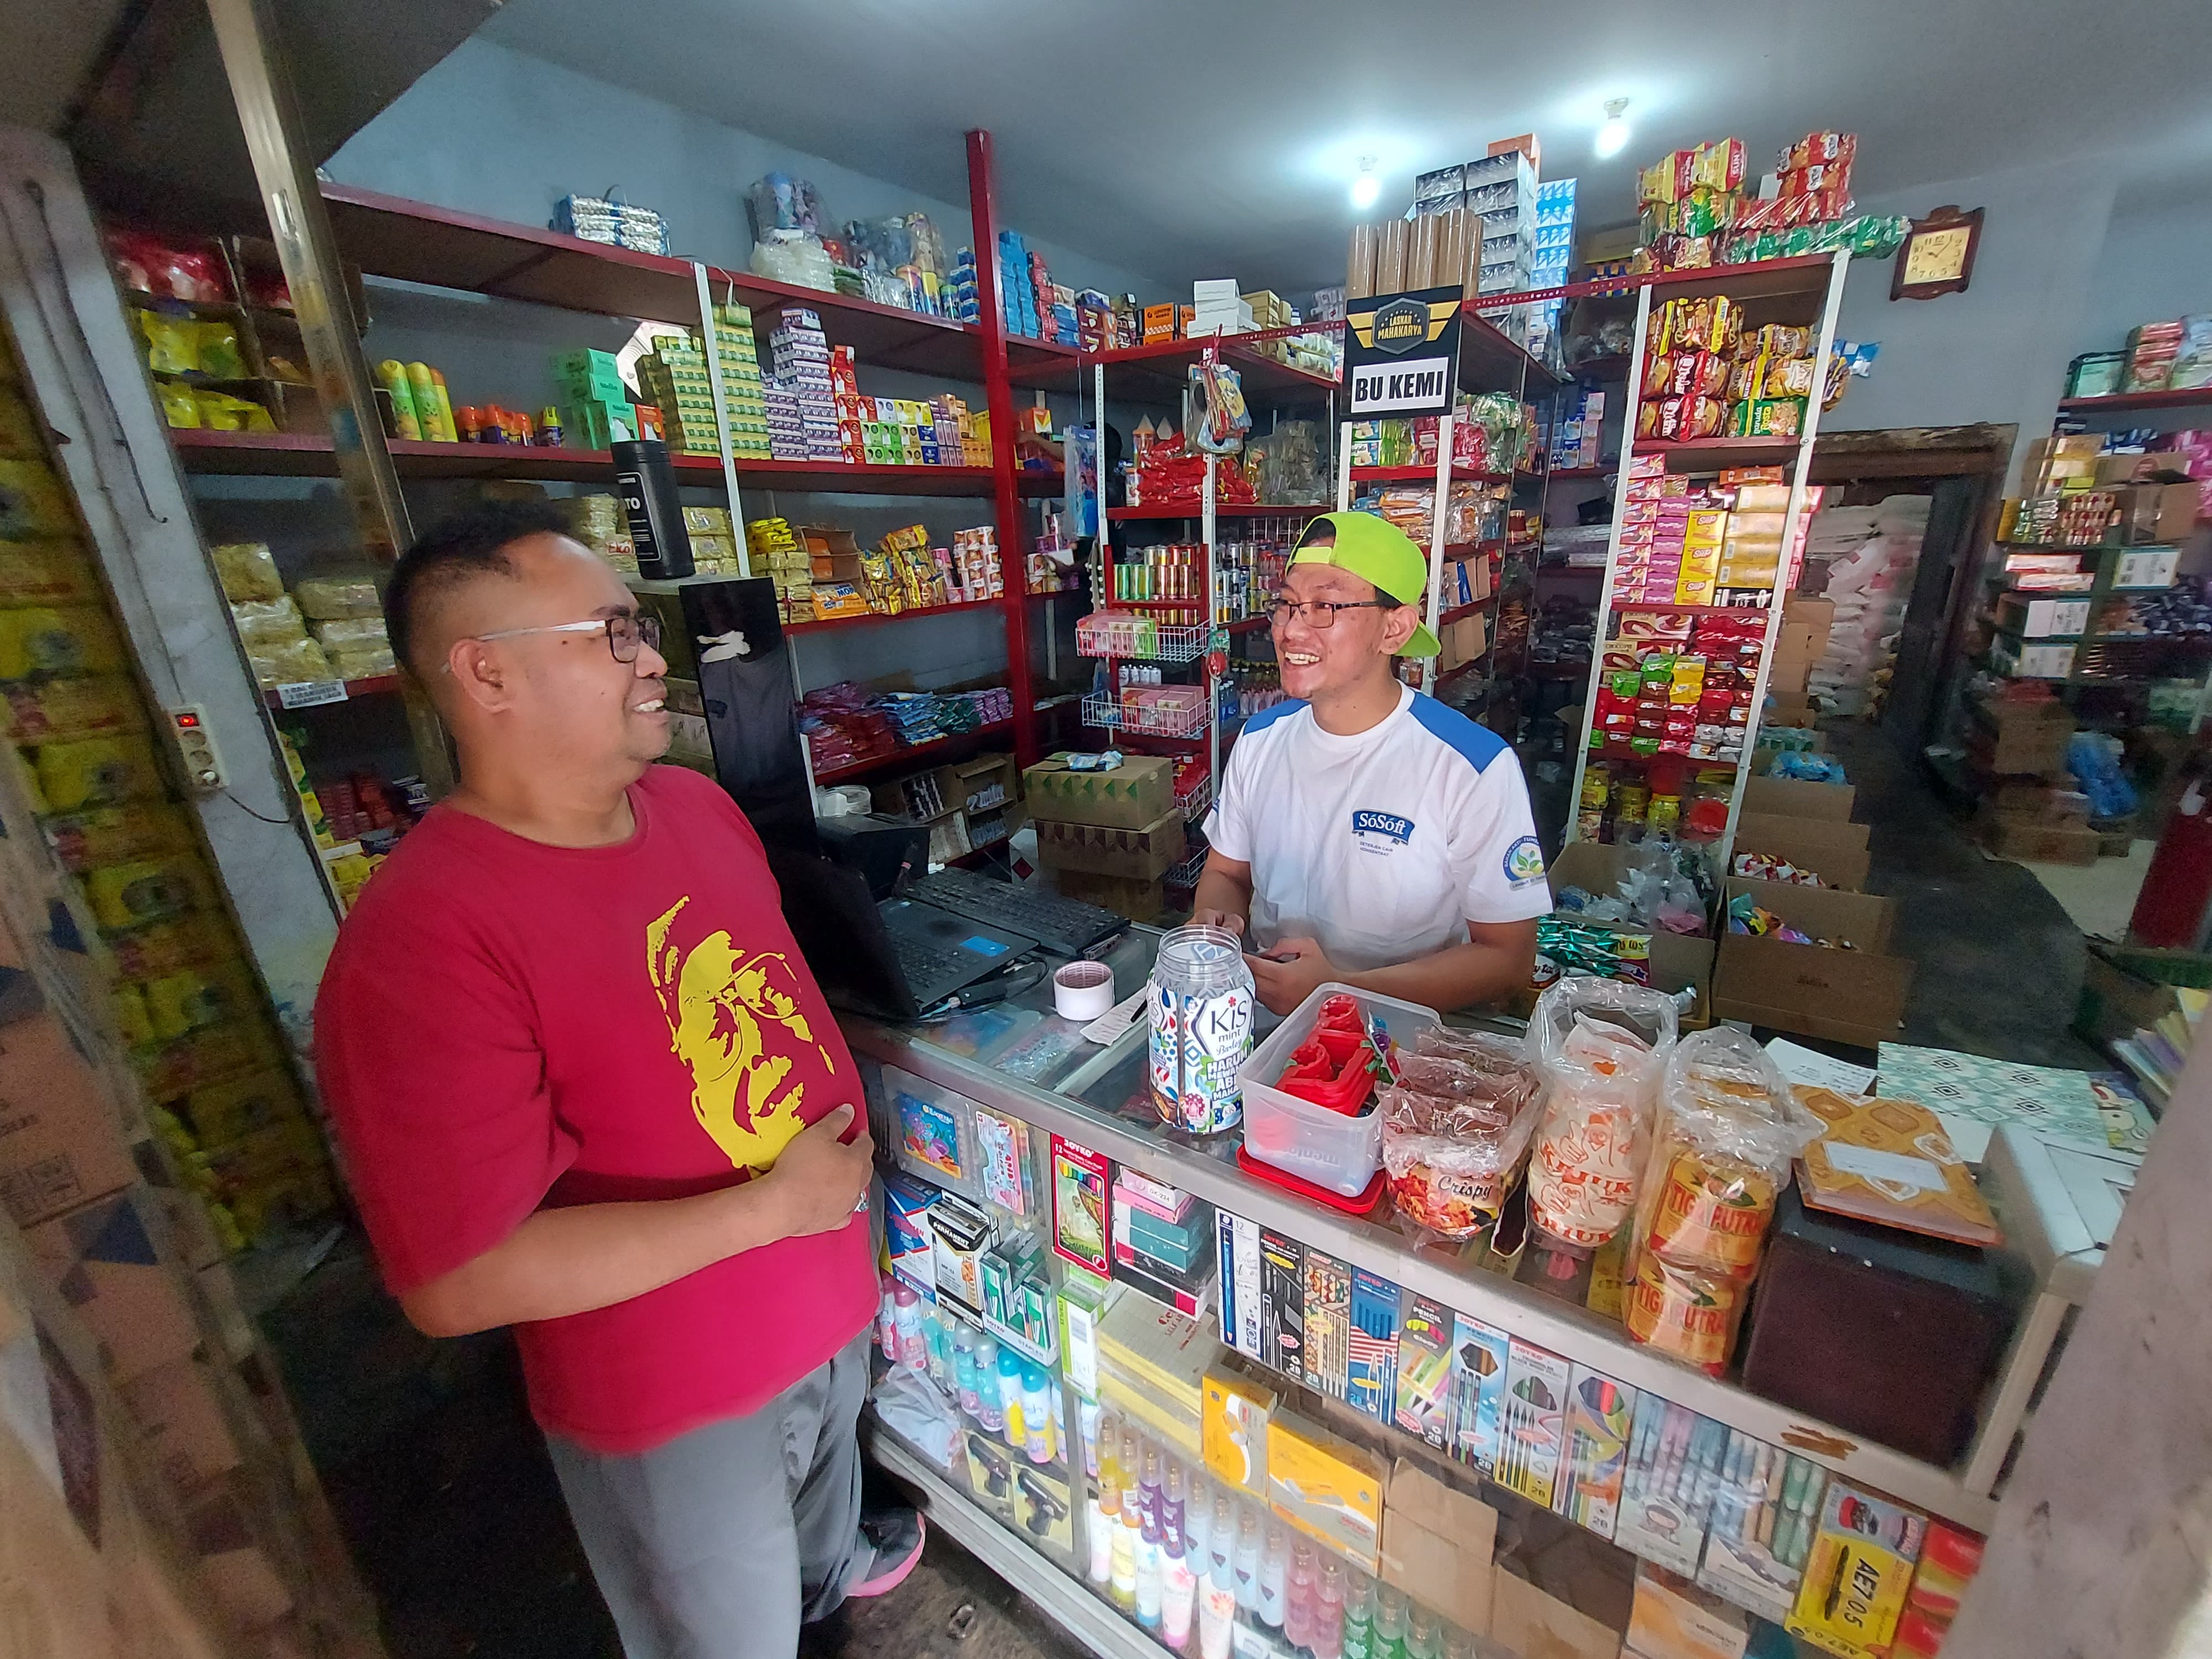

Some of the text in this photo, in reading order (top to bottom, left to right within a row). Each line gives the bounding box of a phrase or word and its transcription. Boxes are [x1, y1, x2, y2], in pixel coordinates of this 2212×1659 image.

[1731, 154, 1741, 176] SUN
[1390, 315, 1412, 326] LASKAR
[1378, 325, 1422, 340] MAHAKARYA
[1355, 371, 1444, 402] BU KEMI
[1219, 1029, 1241, 1042] mint
[1217, 1037, 1242, 1056] Barley
[1207, 1044, 1249, 1073] HARUM
[1055, 1143, 1063, 1154] 12
[1438, 1176, 1493, 1201] Crispy
[933, 1221, 969, 1246] PERMANENT
[1235, 1220, 1244, 1230] 12
[1413, 1306, 1442, 1324] PENCIL
[1478, 1458, 1492, 1470] 2B
[1852, 1557, 1880, 1602] AE7
